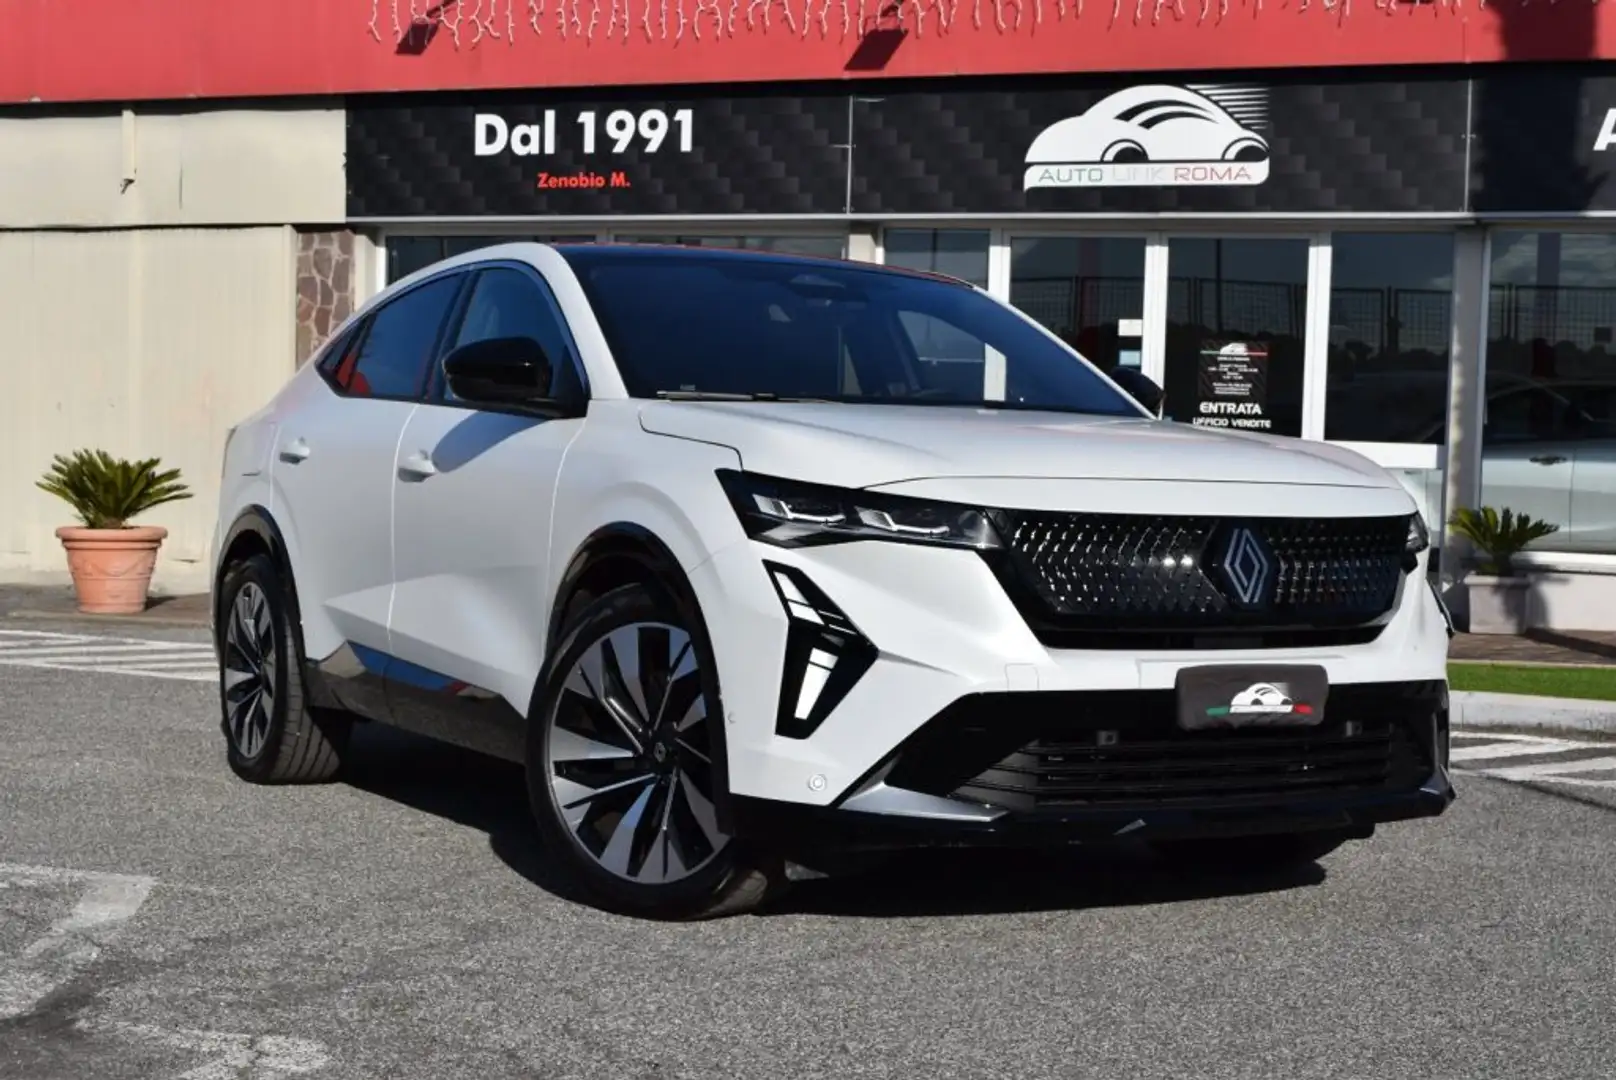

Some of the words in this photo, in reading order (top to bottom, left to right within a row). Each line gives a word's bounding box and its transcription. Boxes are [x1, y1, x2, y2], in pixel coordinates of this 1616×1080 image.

[475, 109, 556, 156] Dal
[577, 109, 693, 154] 1991
[537, 172, 605, 188] Zenobio
[611, 172, 631, 187] M.
[1038, 168, 1103, 182] AUTO
[1174, 166, 1252, 181] ROMA
[1200, 402, 1262, 415] ENTRATA
[1231, 419, 1272, 428] VENDITE
